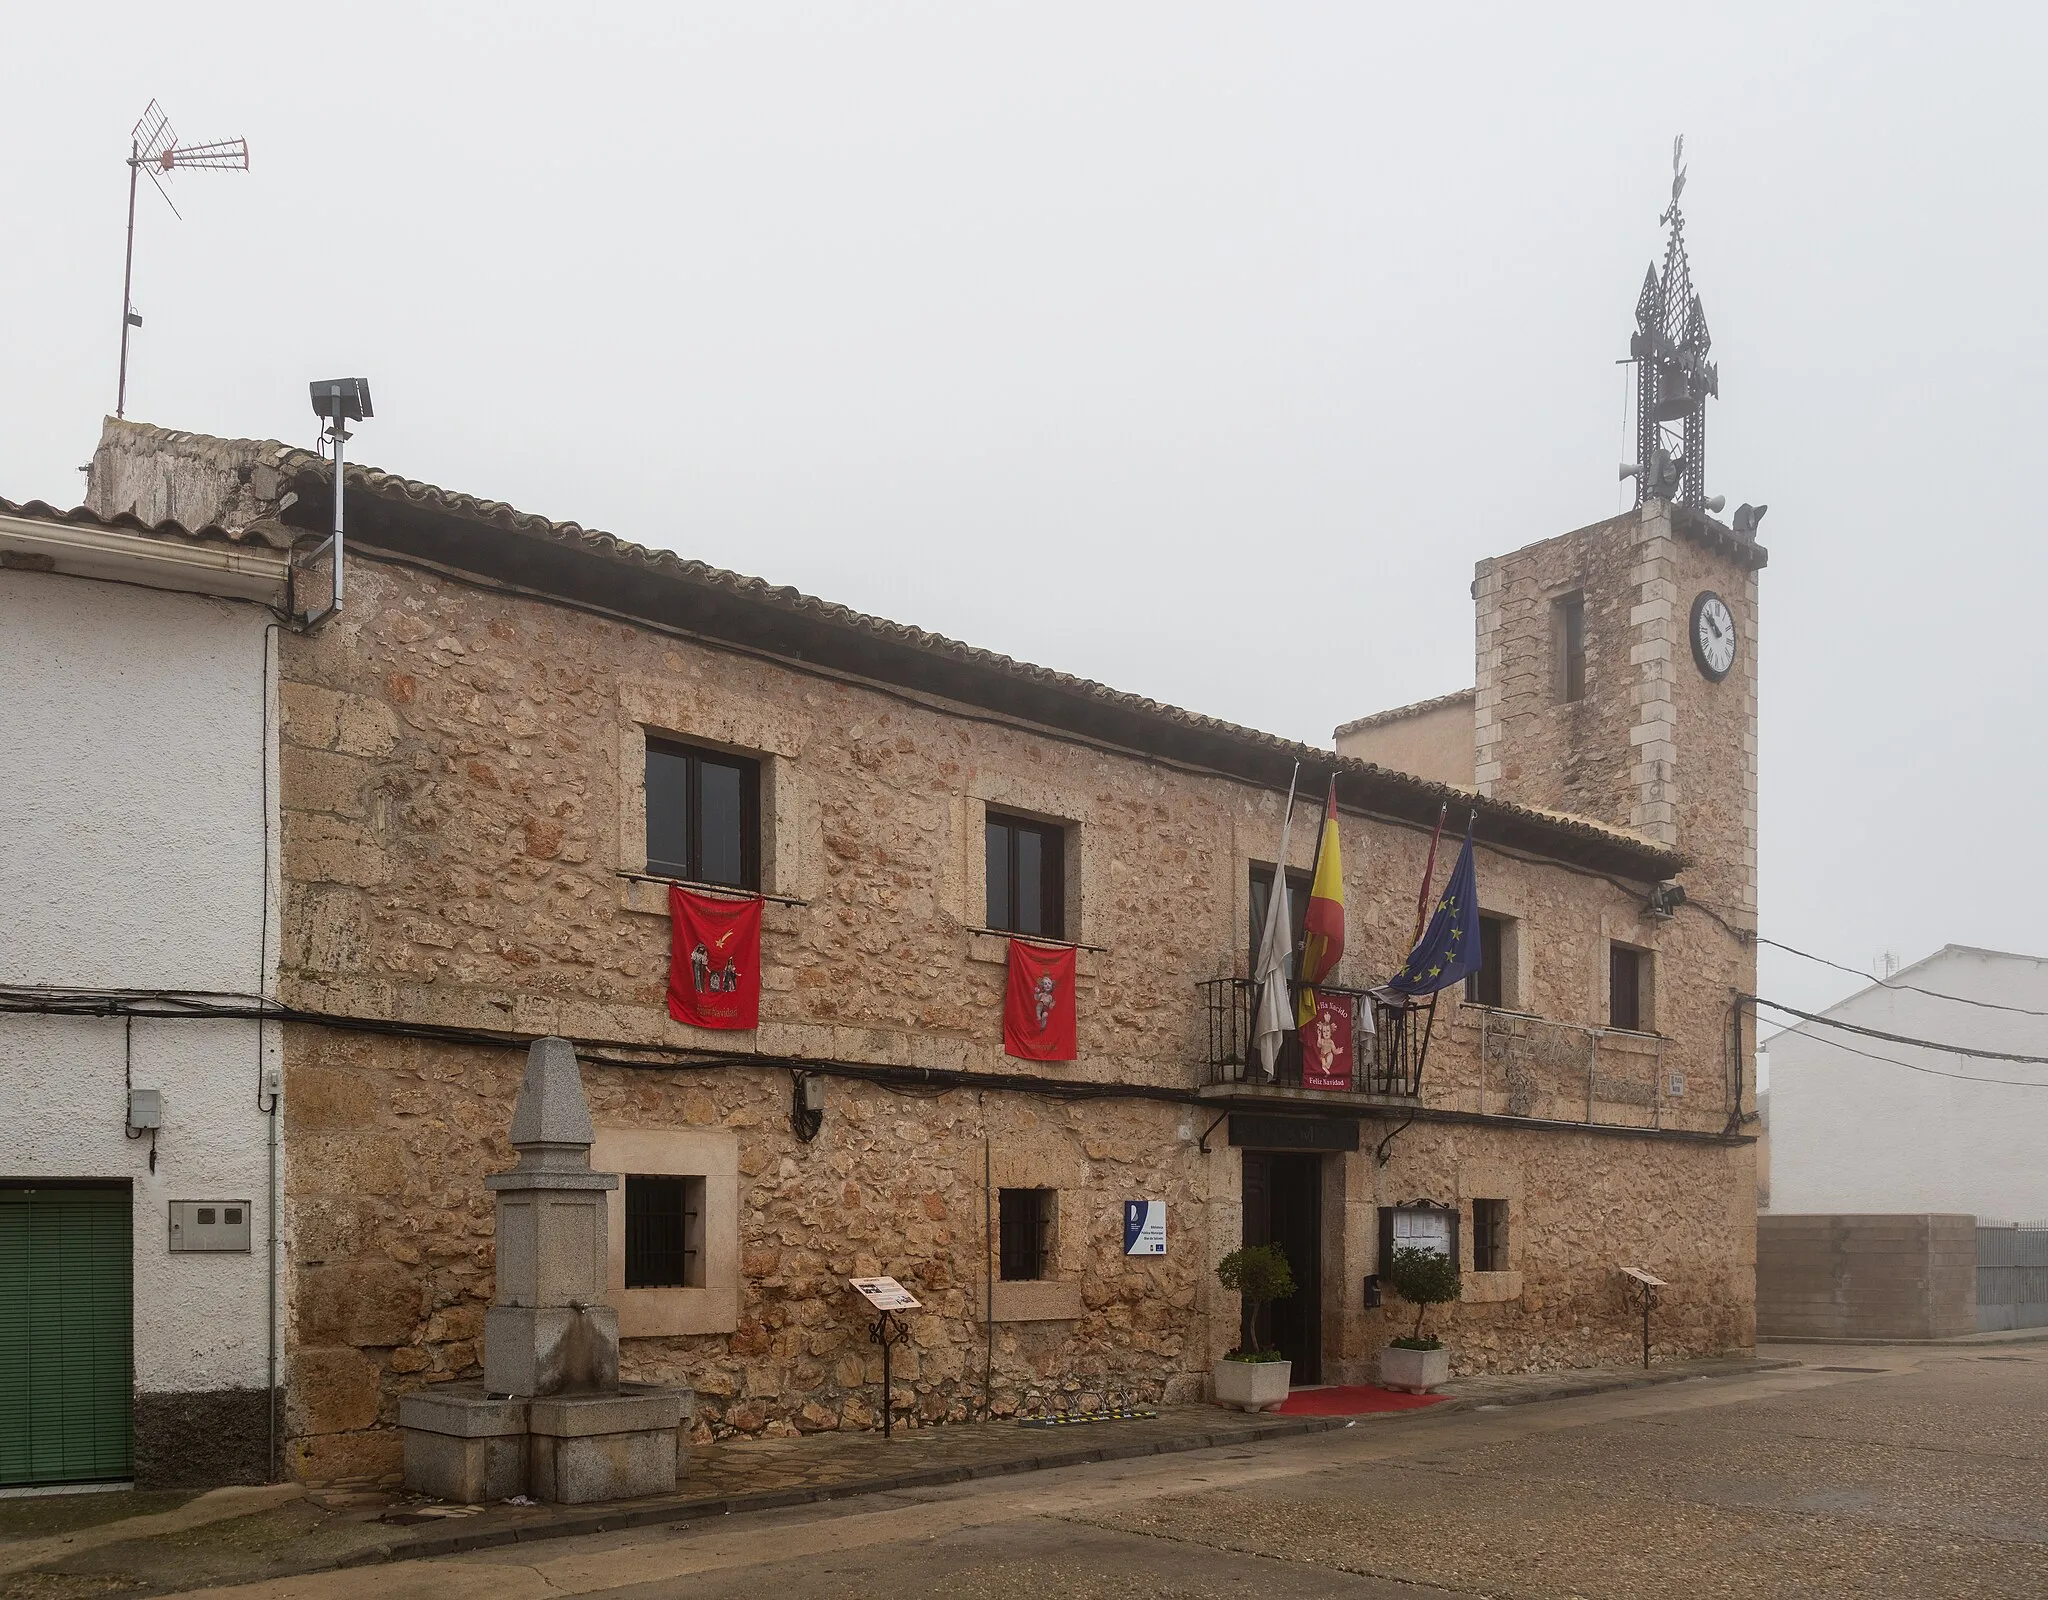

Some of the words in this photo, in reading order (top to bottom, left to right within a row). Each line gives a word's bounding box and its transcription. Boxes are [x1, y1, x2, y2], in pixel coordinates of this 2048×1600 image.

[1329, 1001, 1348, 1018] Nacido
[1309, 1076, 1322, 1085] Feliz
[1322, 1078, 1345, 1086] Navidad
